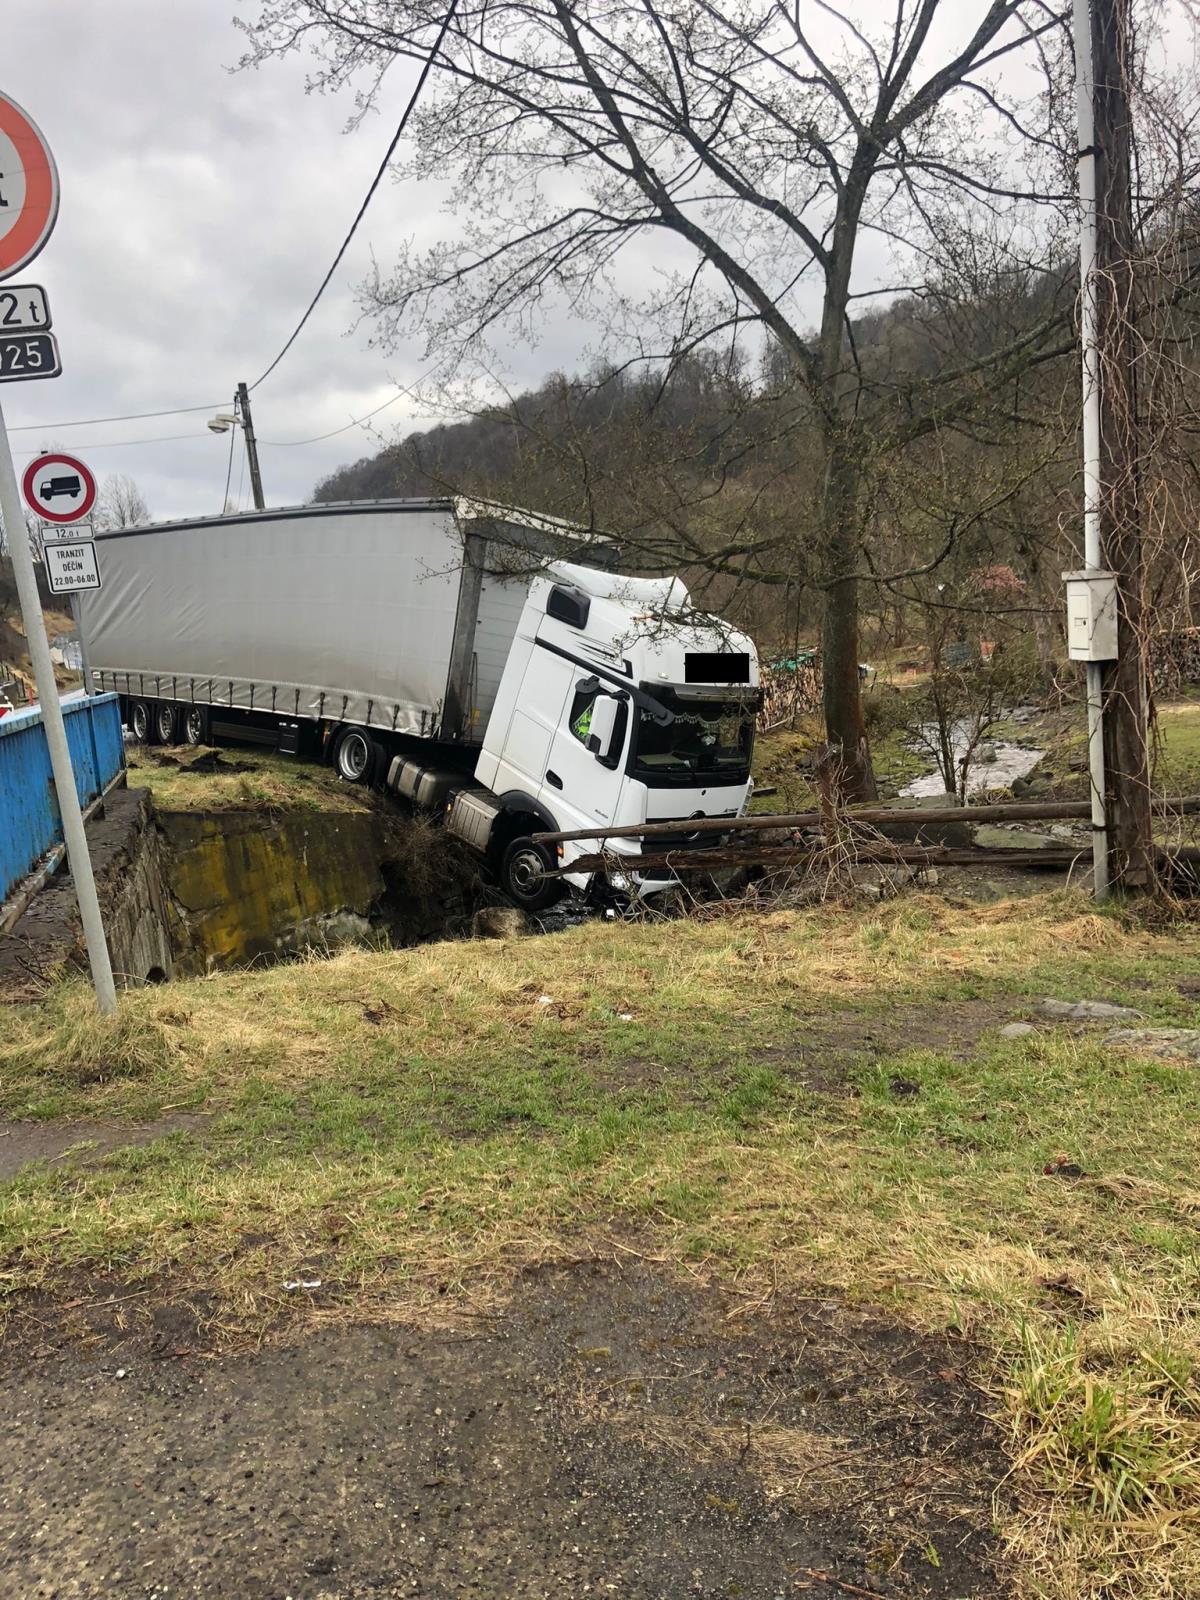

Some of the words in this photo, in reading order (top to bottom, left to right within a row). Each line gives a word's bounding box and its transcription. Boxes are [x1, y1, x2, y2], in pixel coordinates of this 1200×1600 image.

[29, 300, 40, 323] t
[0, 341, 42, 370] 25
[56, 549, 84, 559] TRANZIT
